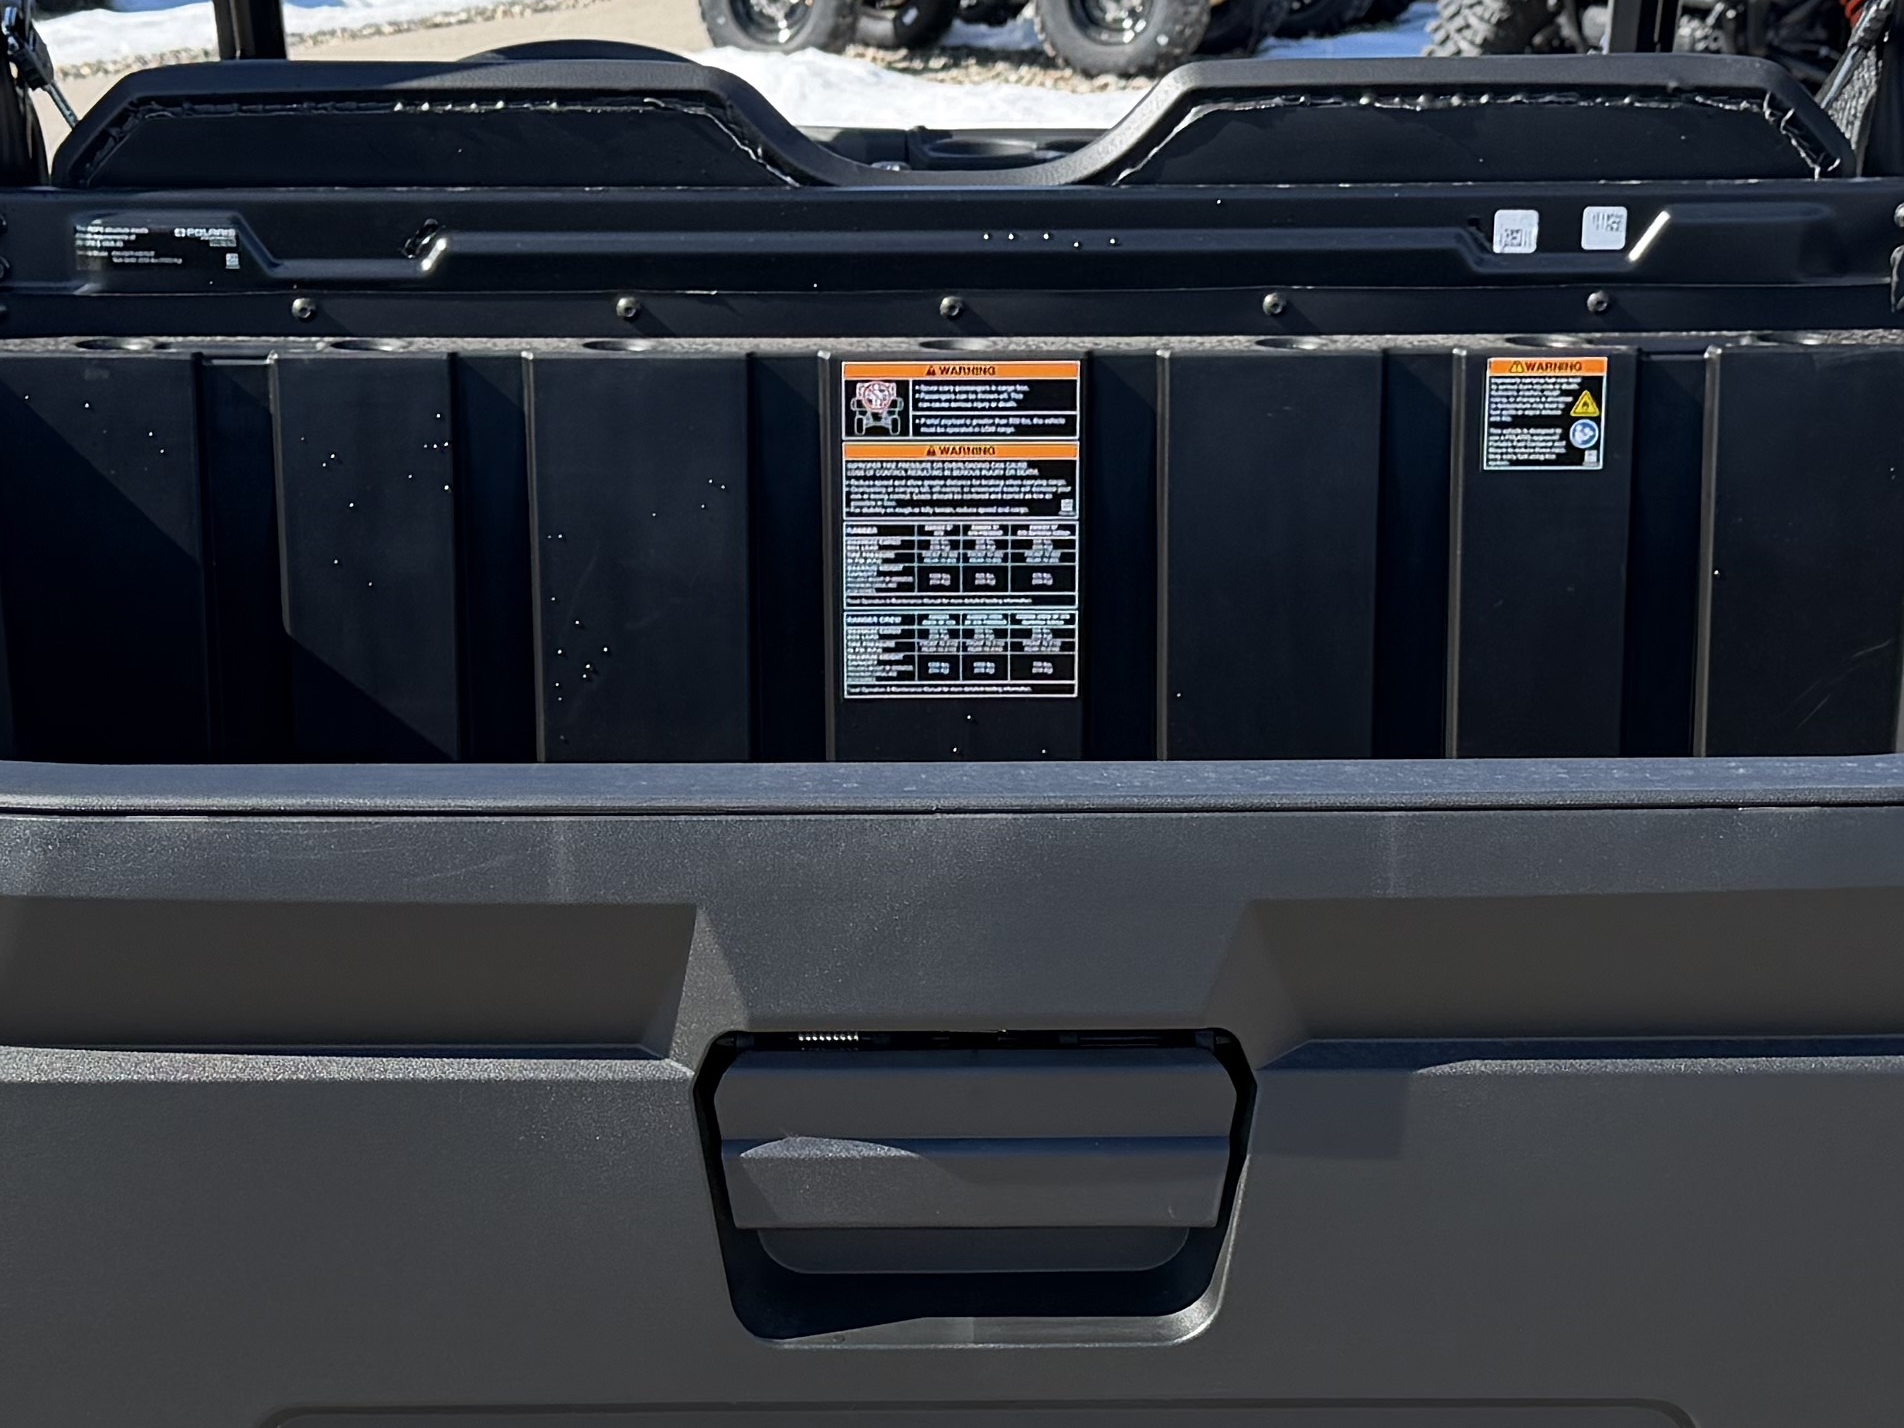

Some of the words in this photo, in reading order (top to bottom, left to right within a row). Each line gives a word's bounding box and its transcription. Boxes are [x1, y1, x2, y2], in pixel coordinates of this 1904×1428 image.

[187, 228, 235, 237] POLARIS
[939, 366, 996, 376] WARNING
[1524, 361, 1583, 372] WARNING
[939, 446, 996, 456] WARNING
